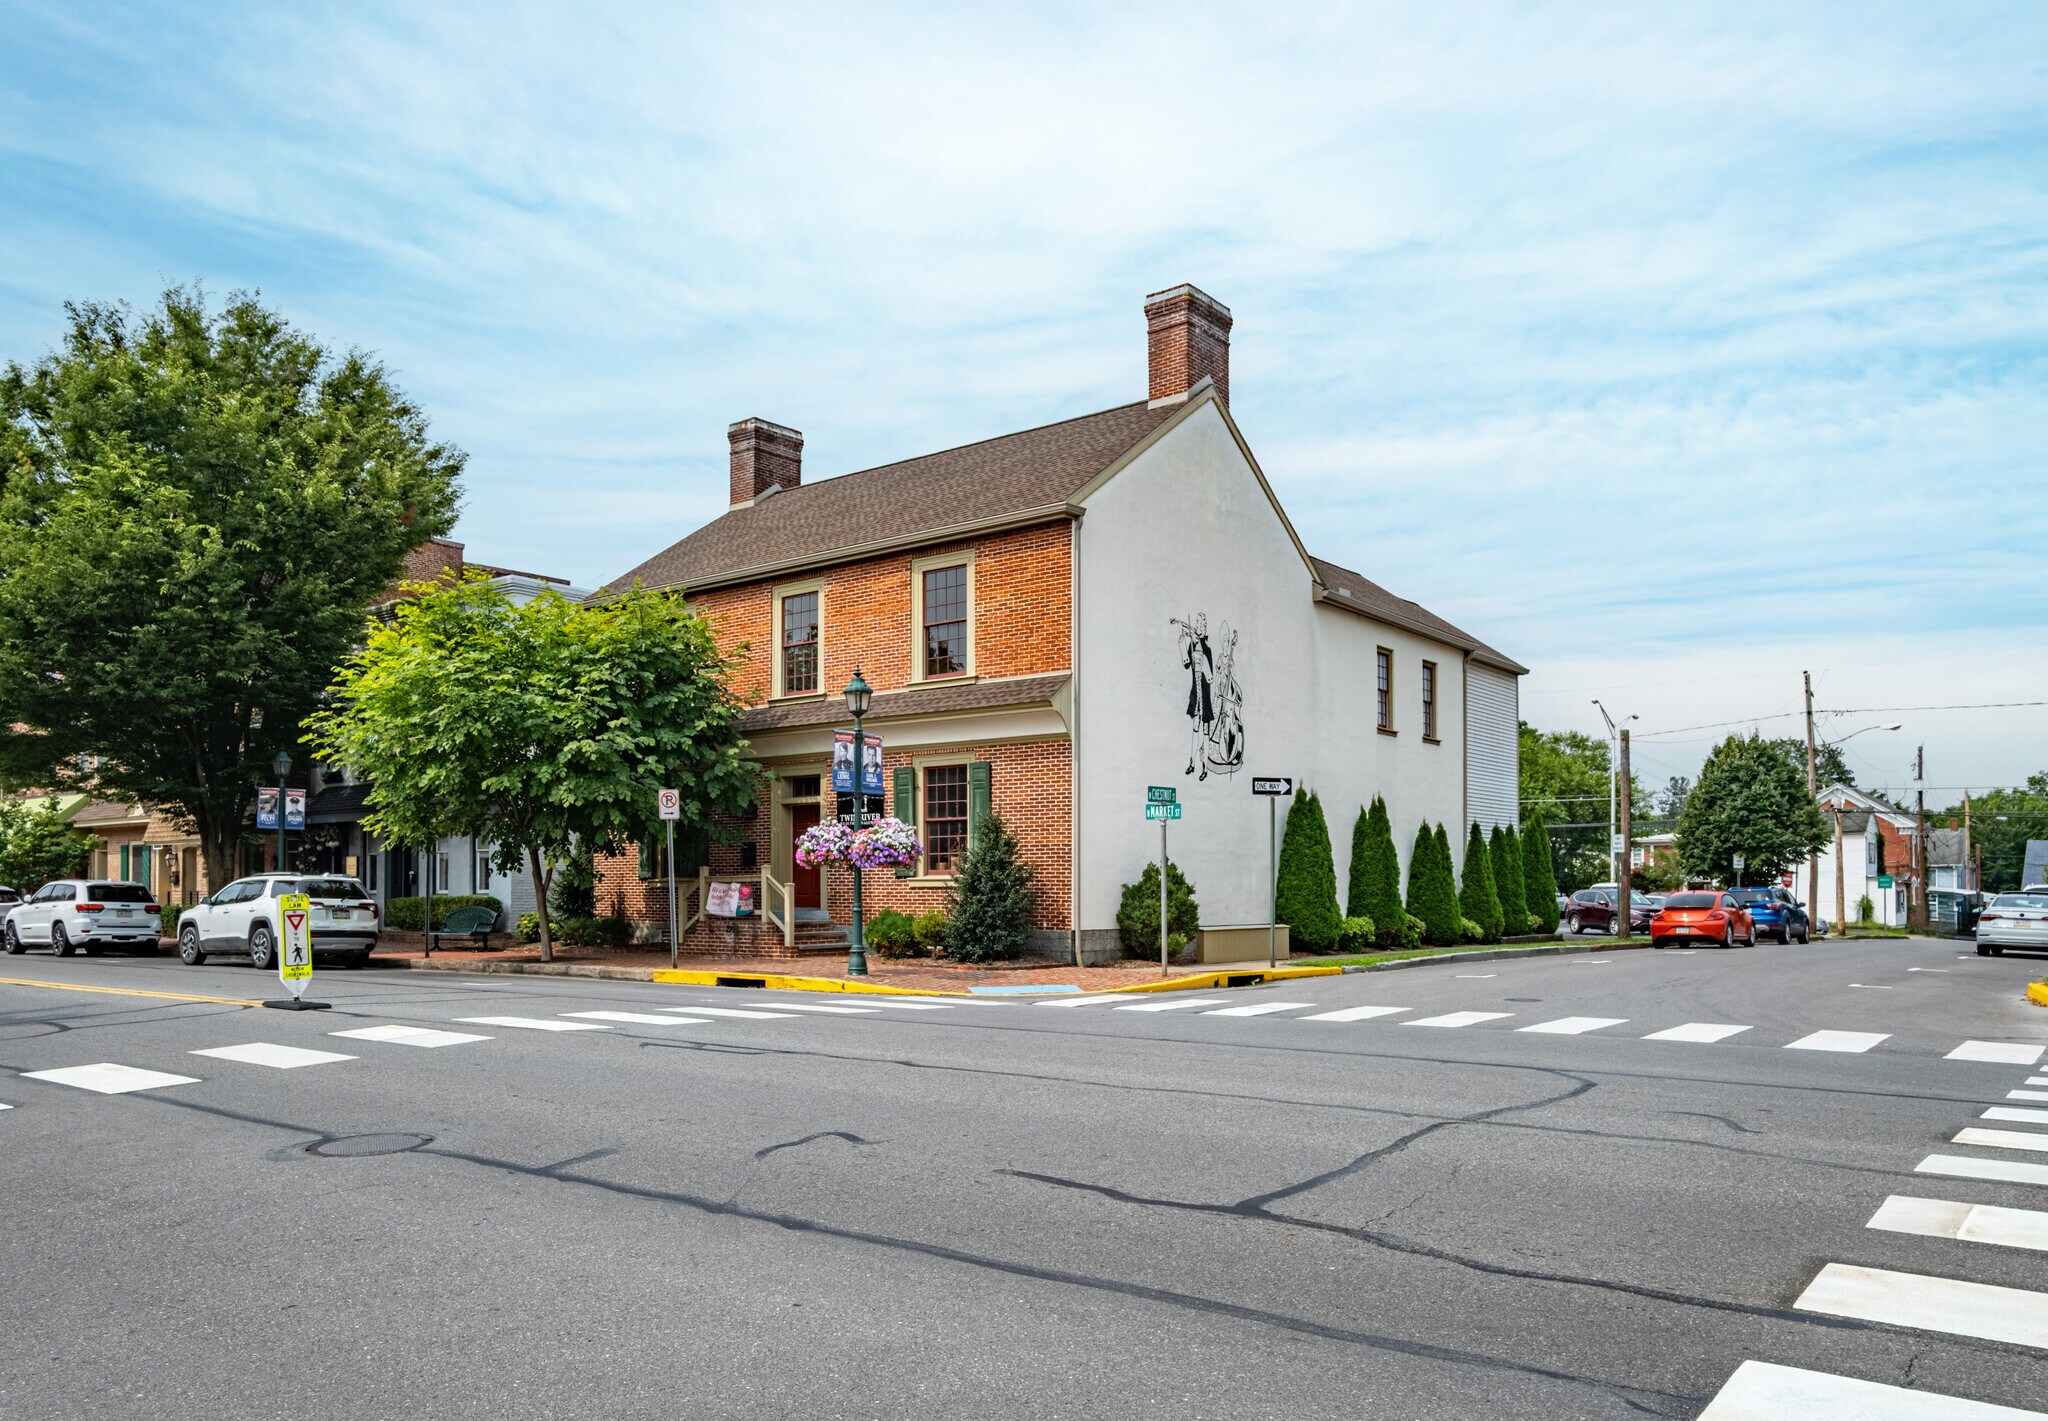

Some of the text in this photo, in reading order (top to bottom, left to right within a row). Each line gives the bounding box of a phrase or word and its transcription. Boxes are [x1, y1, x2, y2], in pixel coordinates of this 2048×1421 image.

[1256, 782, 1267, 790] ONE
[1152, 788, 1172, 801] CHESTNUT
[1150, 805, 1174, 818] MARKET
[1175, 809, 1180, 817] ST
[860, 813, 881, 821] RIVER
